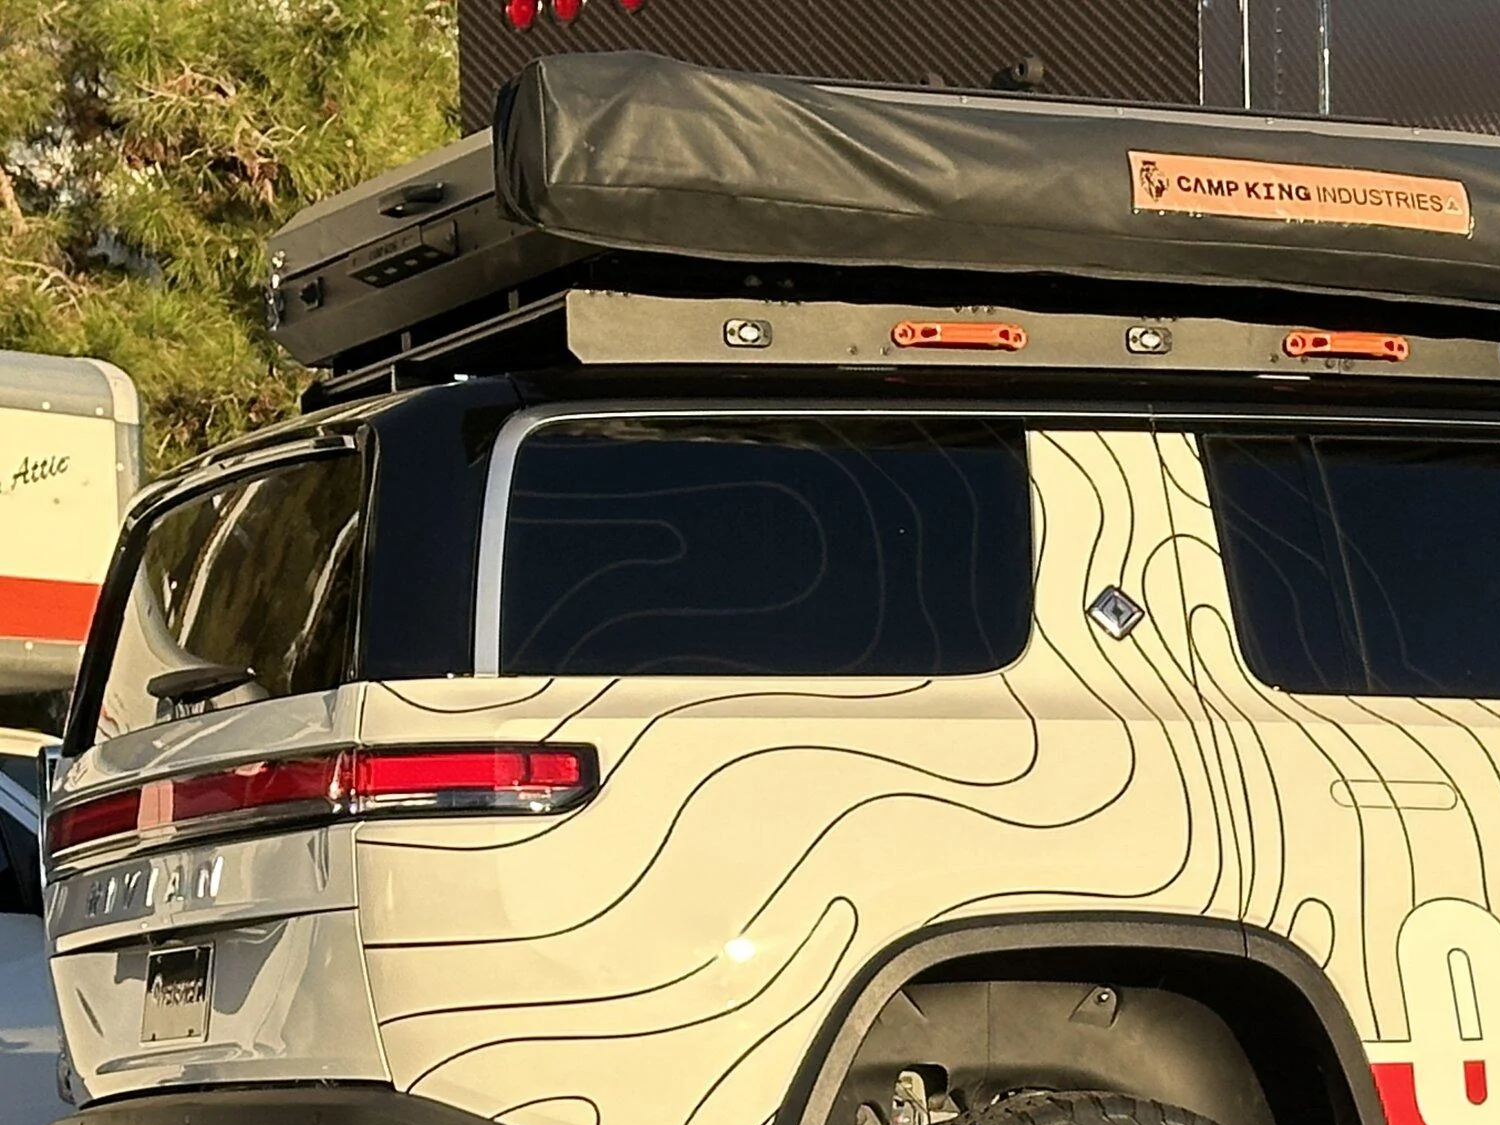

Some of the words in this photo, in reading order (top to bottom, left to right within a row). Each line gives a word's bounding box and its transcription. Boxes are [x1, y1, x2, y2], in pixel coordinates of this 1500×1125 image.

[1177, 175, 1239, 198] CAMP
[1245, 181, 1312, 202] KING
[1316, 185, 1444, 213] INDUSTRIES
[11, 455, 70, 491] Attic
